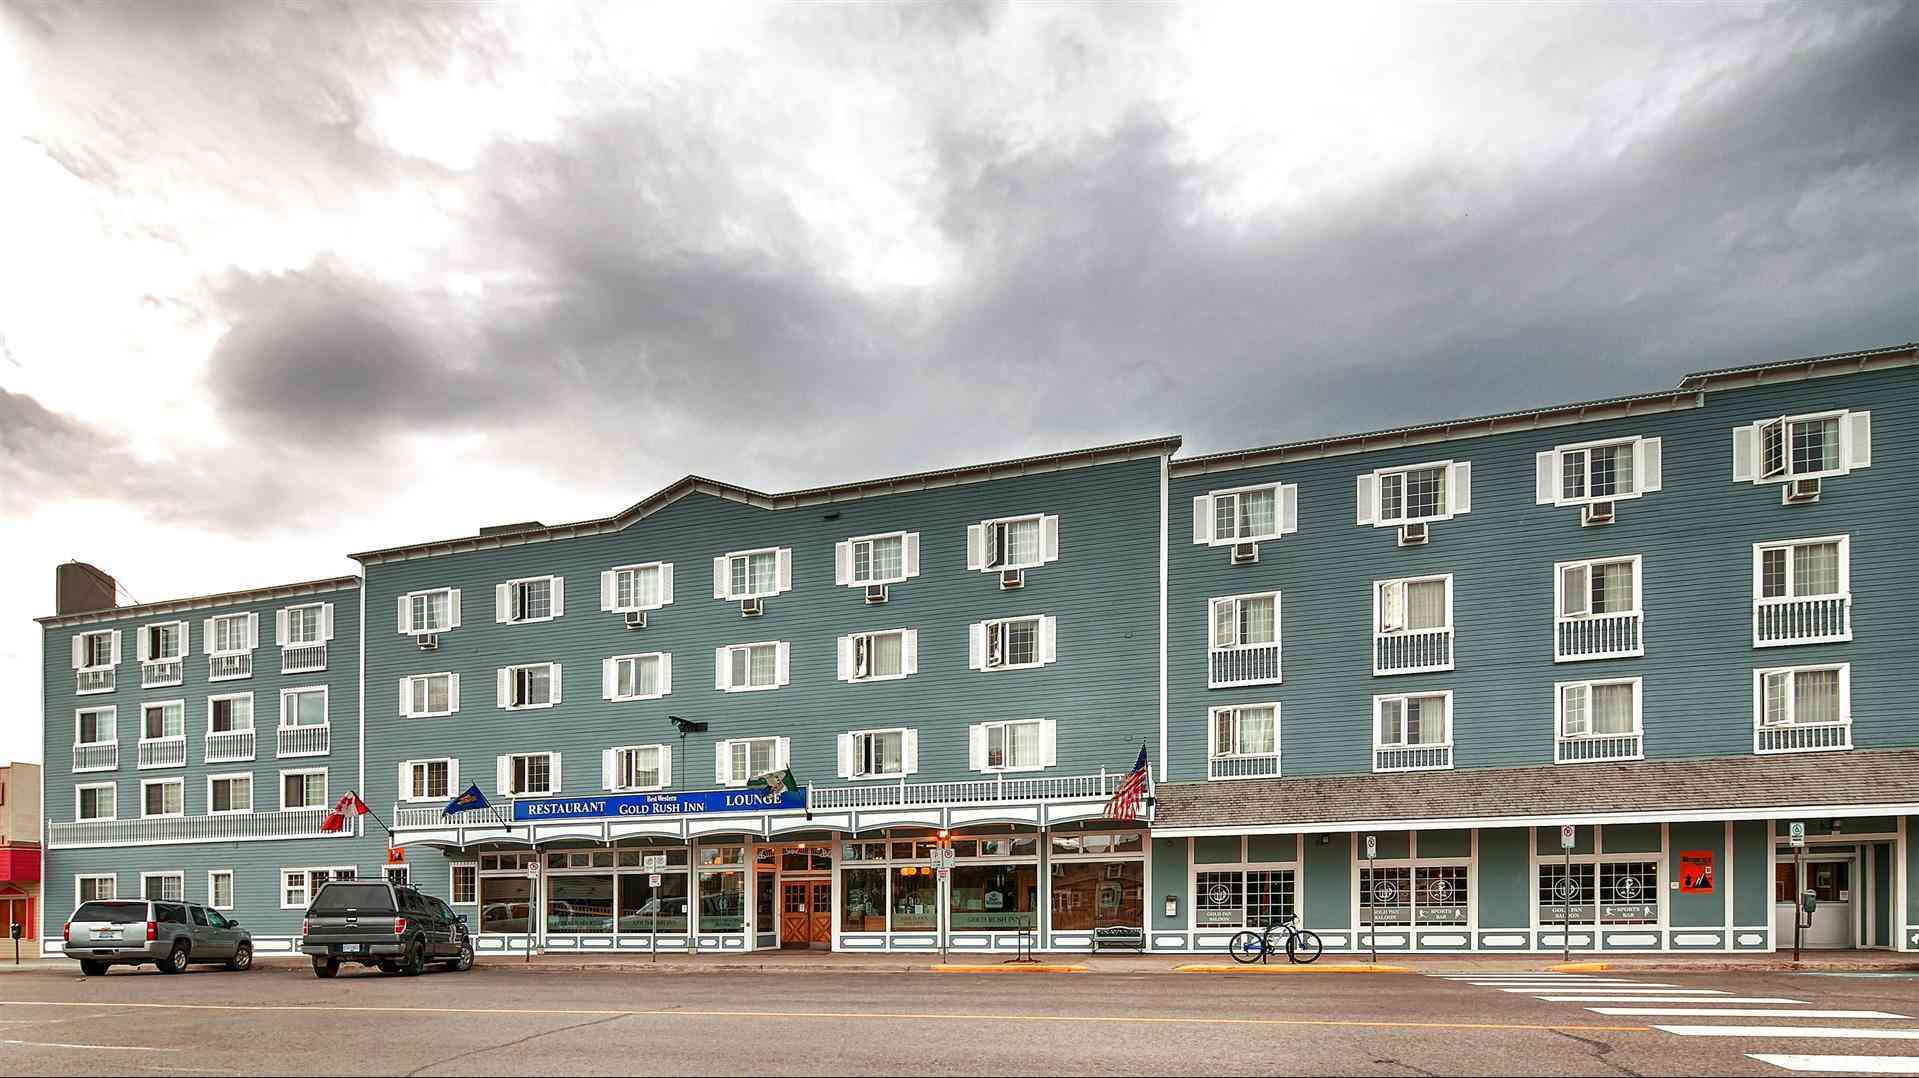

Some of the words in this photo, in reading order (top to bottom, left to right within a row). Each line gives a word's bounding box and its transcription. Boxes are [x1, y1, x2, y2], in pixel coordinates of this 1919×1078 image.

[726, 793, 781, 806] LOUNGE
[528, 801, 606, 815] RESTAURANT
[619, 804, 649, 815] GOLD
[652, 803, 680, 813] RUSH
[684, 801, 705, 812] INN
